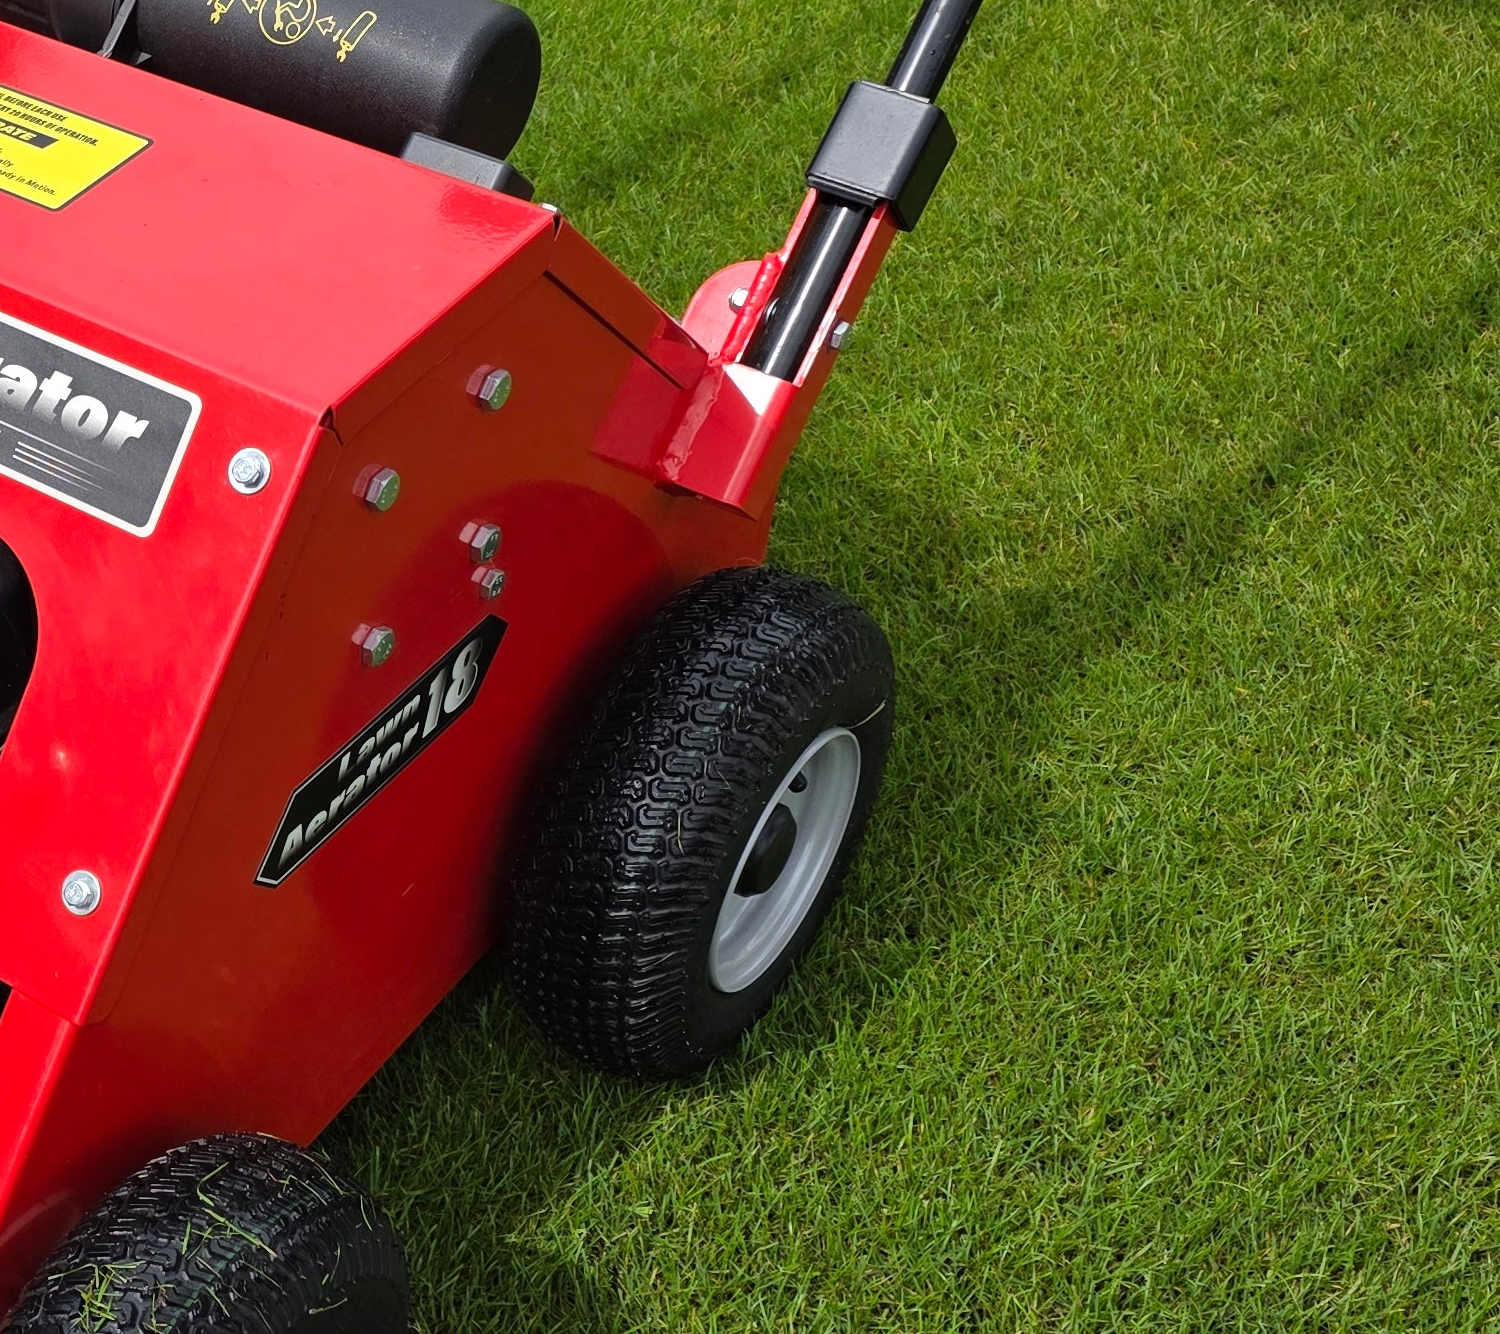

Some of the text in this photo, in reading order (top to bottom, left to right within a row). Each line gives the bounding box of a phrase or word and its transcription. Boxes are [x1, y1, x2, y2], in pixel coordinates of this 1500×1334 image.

[3, 95, 34, 110] BEFORE
[31, 105, 54, 117] EACH
[50, 113, 68, 122] USE
[19, 113, 48, 126] HOURS
[45, 122, 57, 130] OF
[422, 637, 484, 739] 18
[338, 694, 421, 782] Lawn
[277, 721, 420, 869] Aerator
